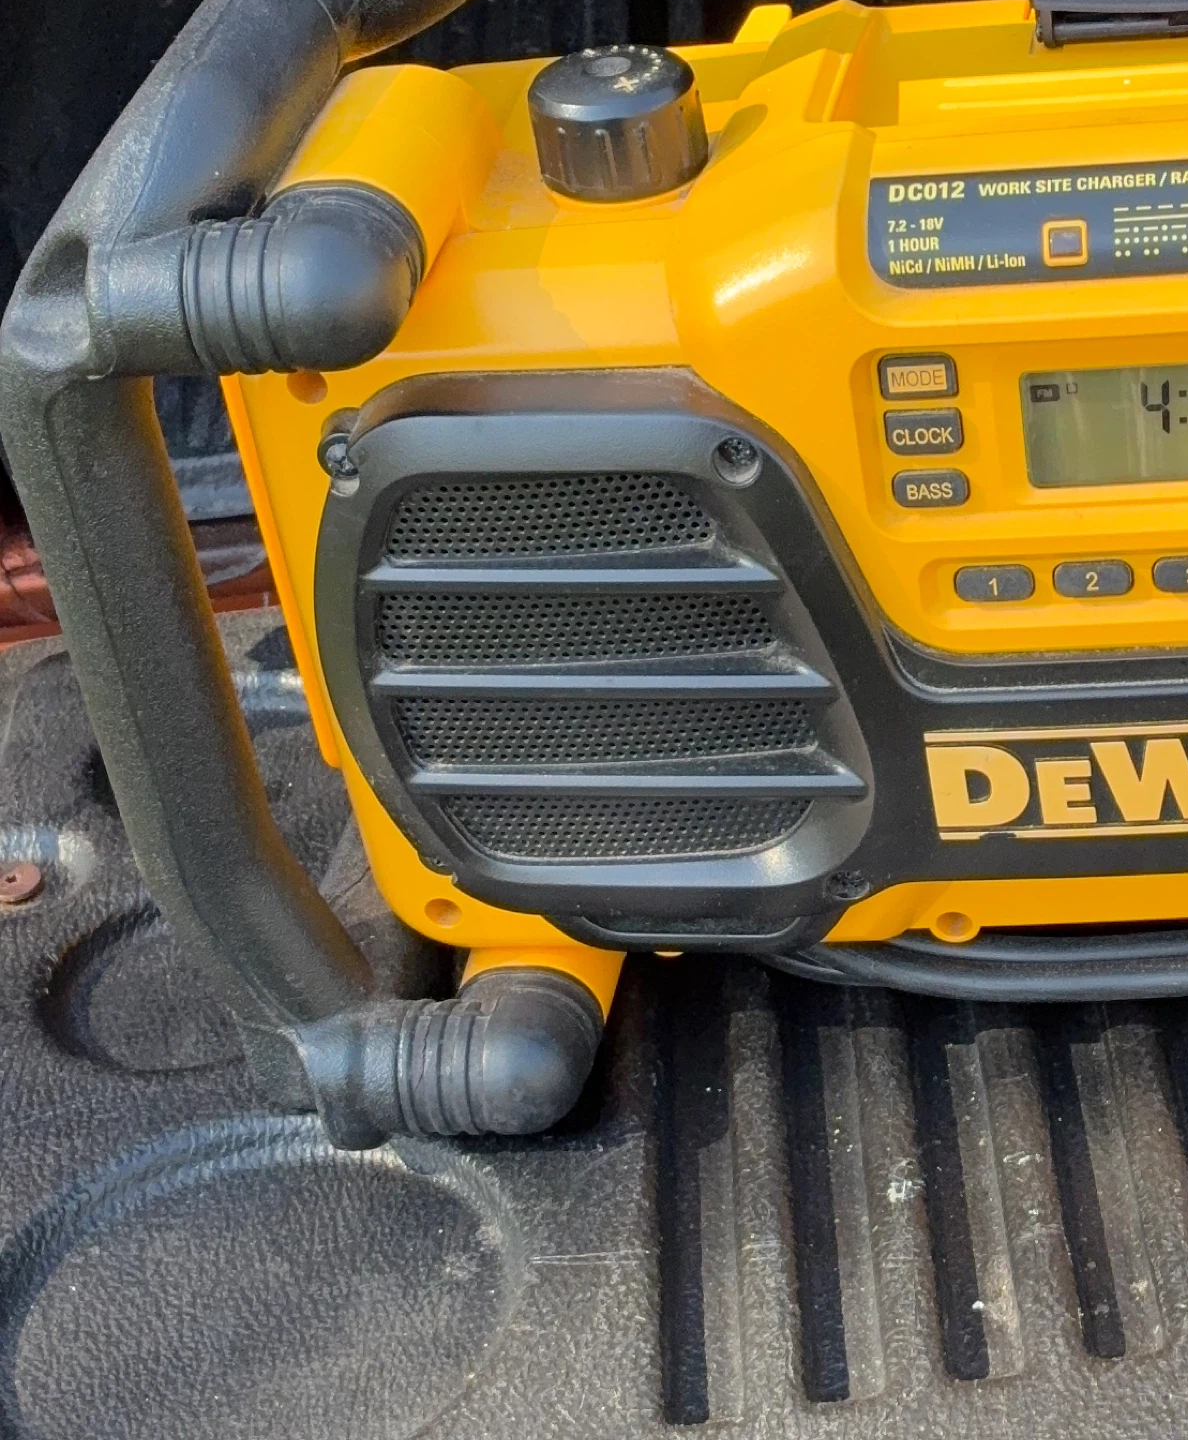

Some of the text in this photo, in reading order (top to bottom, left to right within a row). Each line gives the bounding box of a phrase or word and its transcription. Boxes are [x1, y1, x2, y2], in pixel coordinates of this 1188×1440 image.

[888, 180, 966, 203] DC012
[978, 180, 1031, 197] WORK
[1035, 177, 1072, 194] SITE
[1076, 172, 1157, 191] CHARGER
[1159, 171, 1168, 188] /
[887, 219, 907, 233] 7.2
[919, 216, 945, 231] 18V
[888, 236, 940, 253] 1 HOUR
[889, 259, 923, 276] NiCd
[934, 255, 975, 273] NiMH
[986, 253, 1026, 270] Li-Ion
[890, 368, 945, 388] MODE
[892, 427, 954, 446] CLOCK
[906, 482, 953, 501] BASS
[988, 577, 998, 596] 1
[1085, 571, 1099, 592] 2
